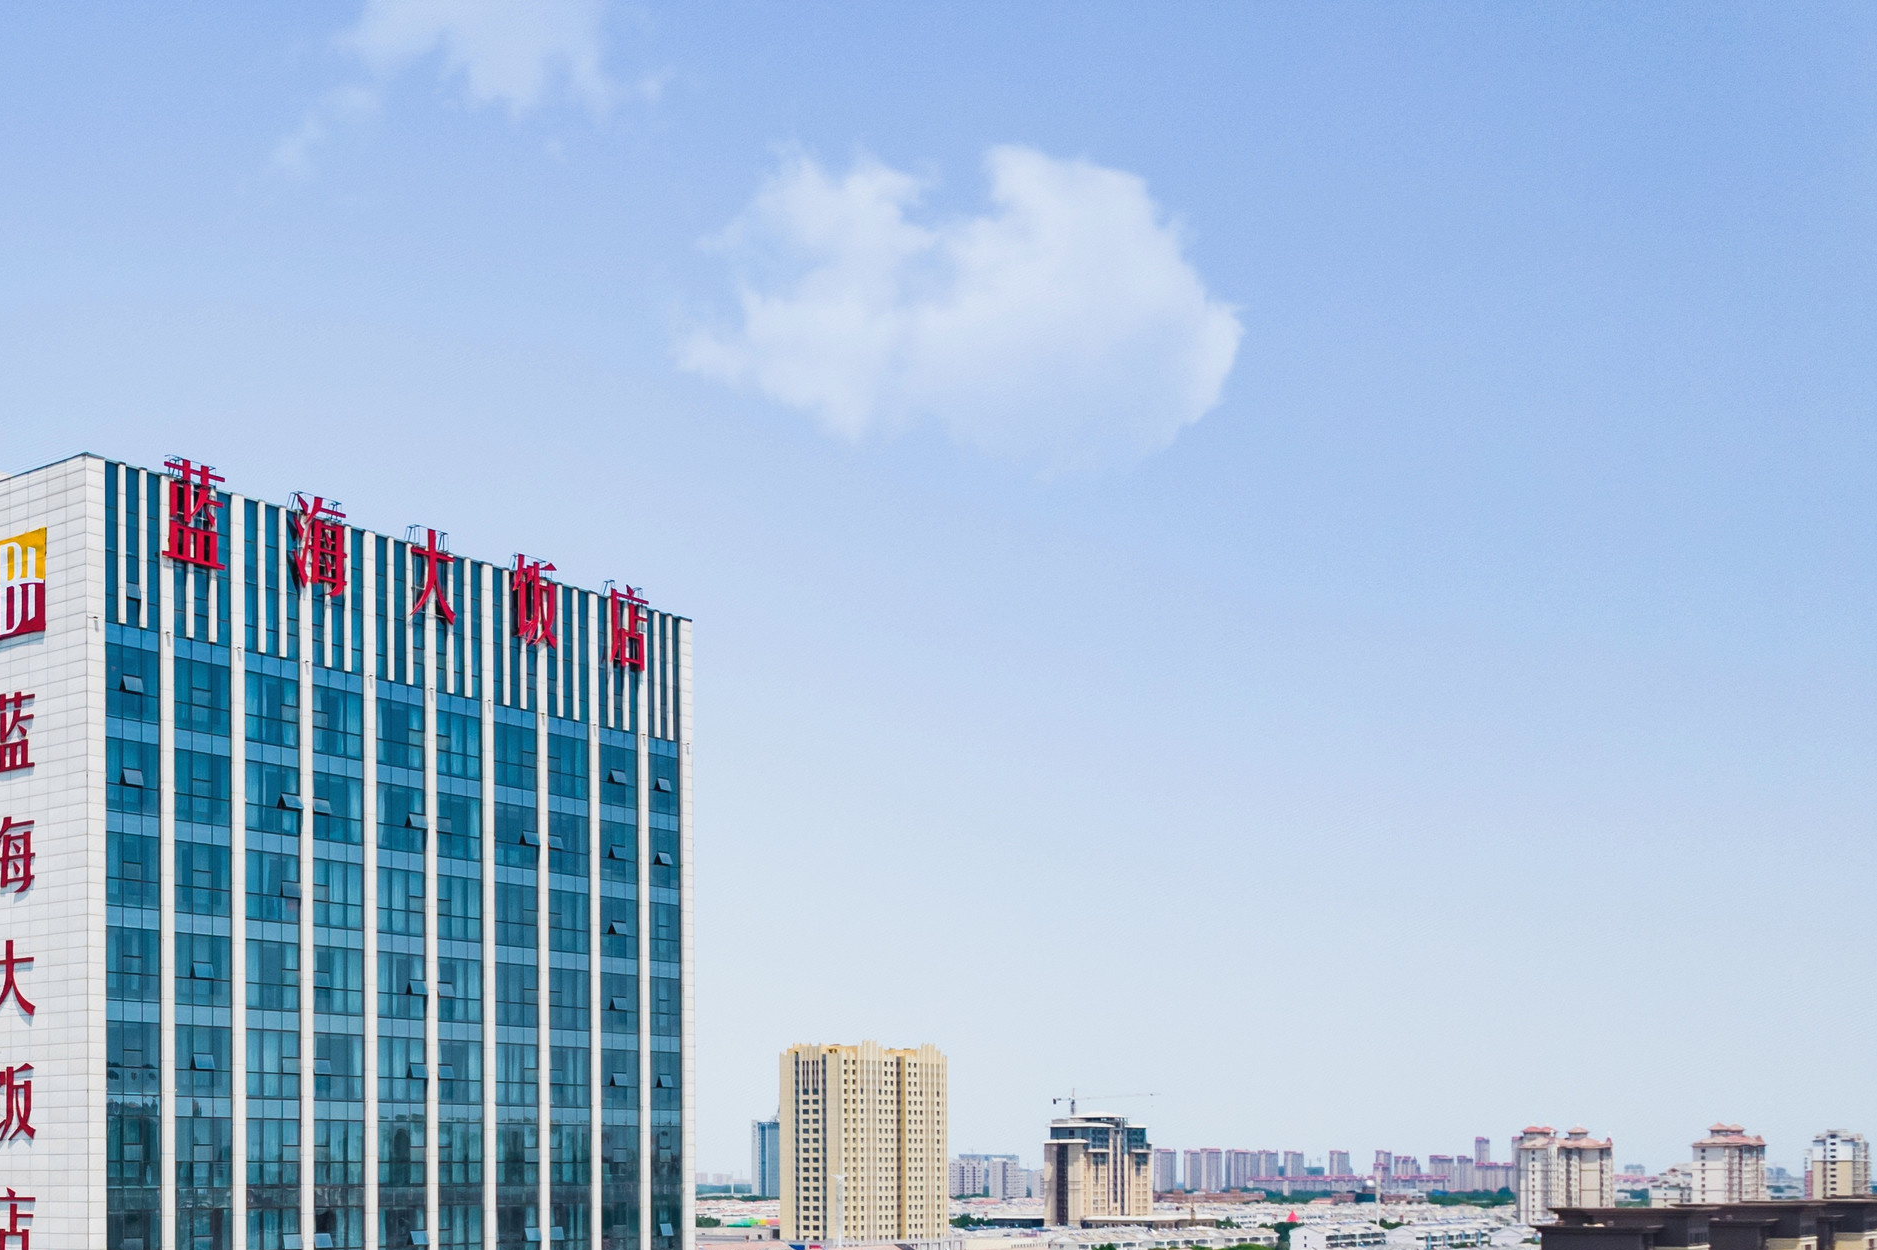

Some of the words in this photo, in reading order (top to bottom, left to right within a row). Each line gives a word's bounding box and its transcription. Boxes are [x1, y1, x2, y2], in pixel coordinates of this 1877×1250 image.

[162, 458, 649, 672] 蓝海大饭店
